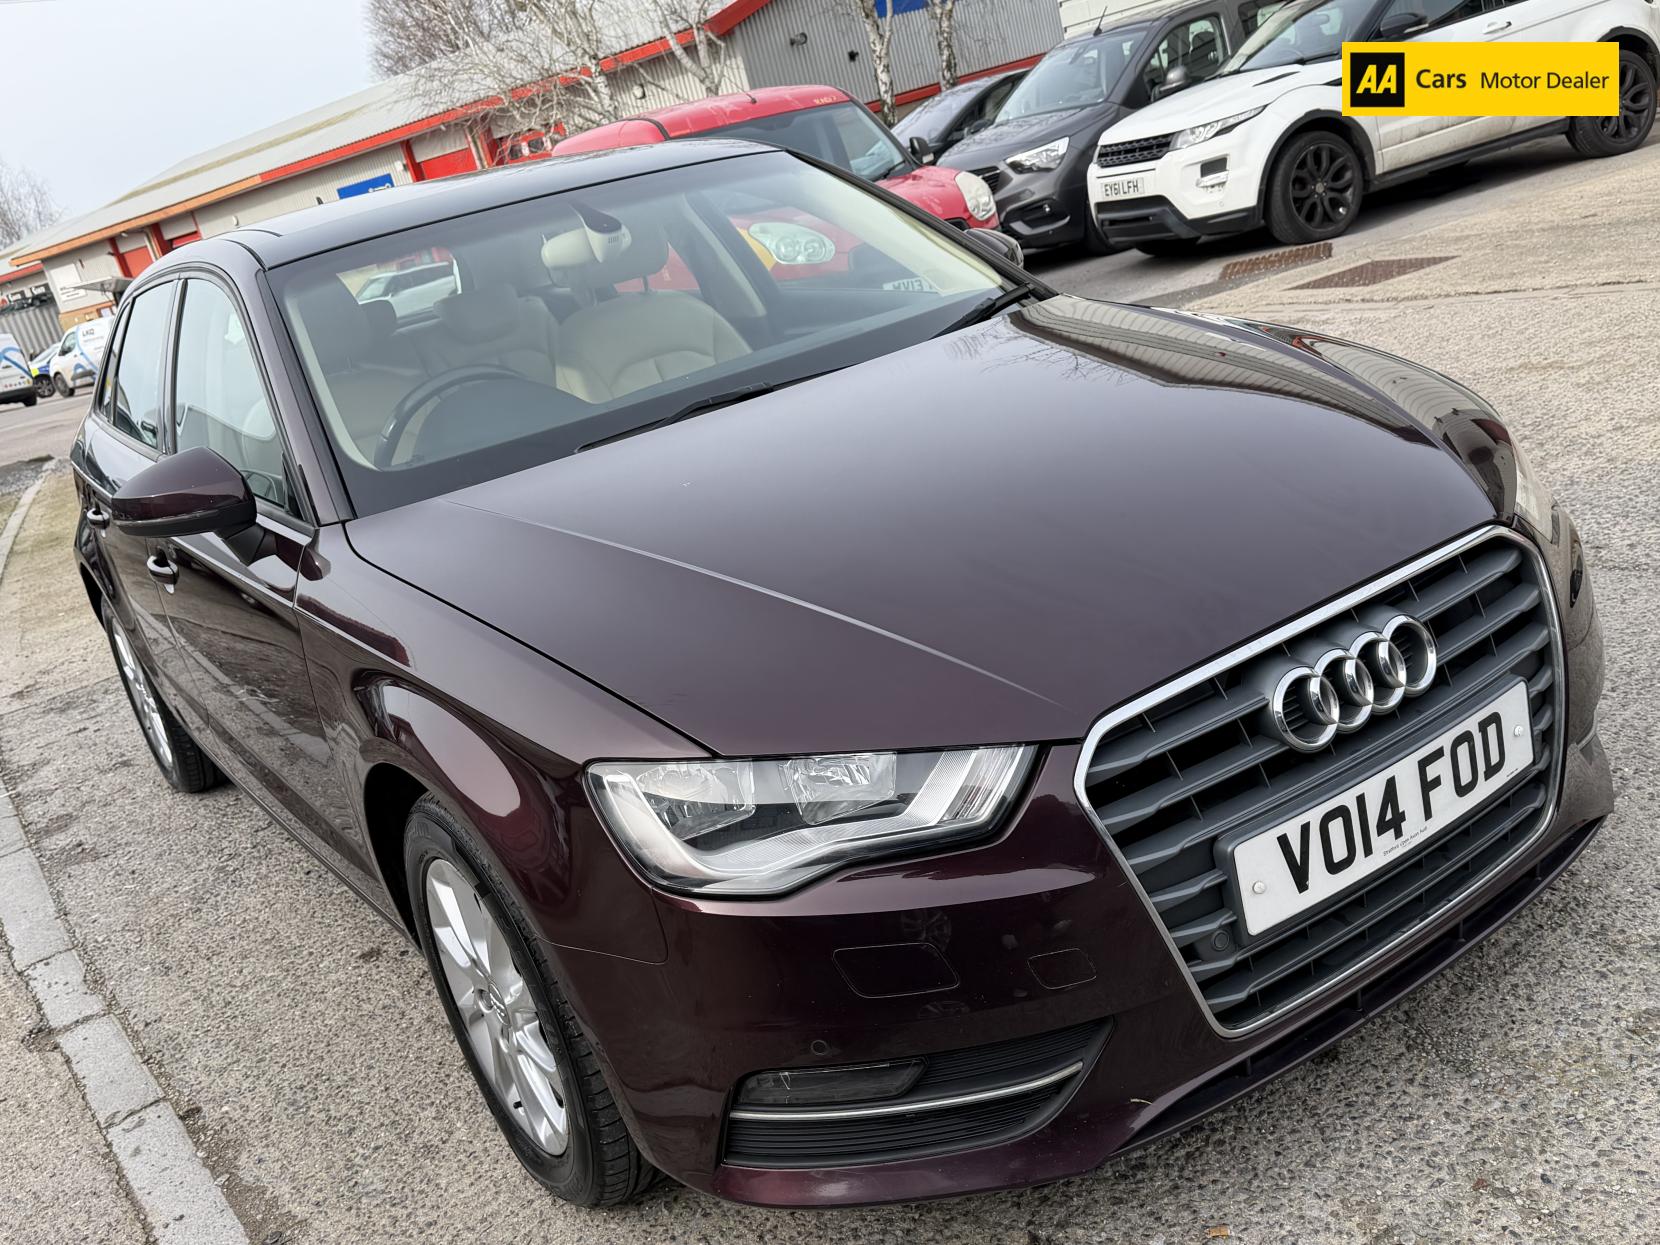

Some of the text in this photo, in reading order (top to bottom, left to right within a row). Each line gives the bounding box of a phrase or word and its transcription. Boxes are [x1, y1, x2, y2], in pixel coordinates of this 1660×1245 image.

[1104, 179, 1139, 197] EY61 LFH
[1276, 711, 1506, 895] VO14 FOD
